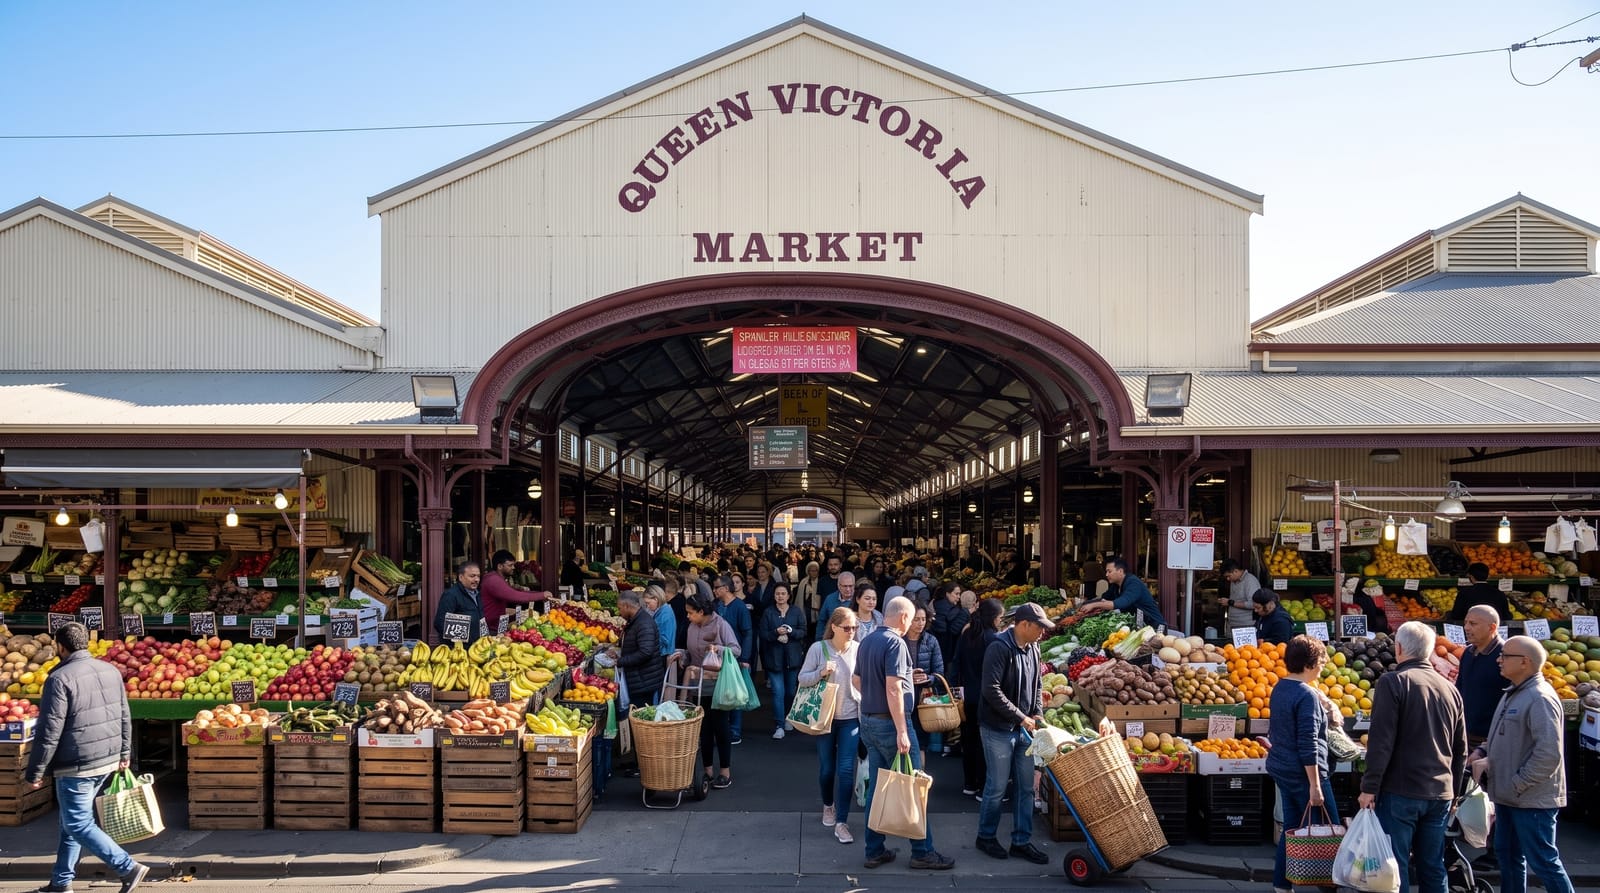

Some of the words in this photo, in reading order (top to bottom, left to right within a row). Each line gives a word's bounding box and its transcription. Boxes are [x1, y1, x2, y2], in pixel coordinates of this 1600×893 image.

[618, 91, 754, 213] QUEEN
[768, 82, 987, 210] VICTORIA
[693, 232, 923, 262] MARKET
